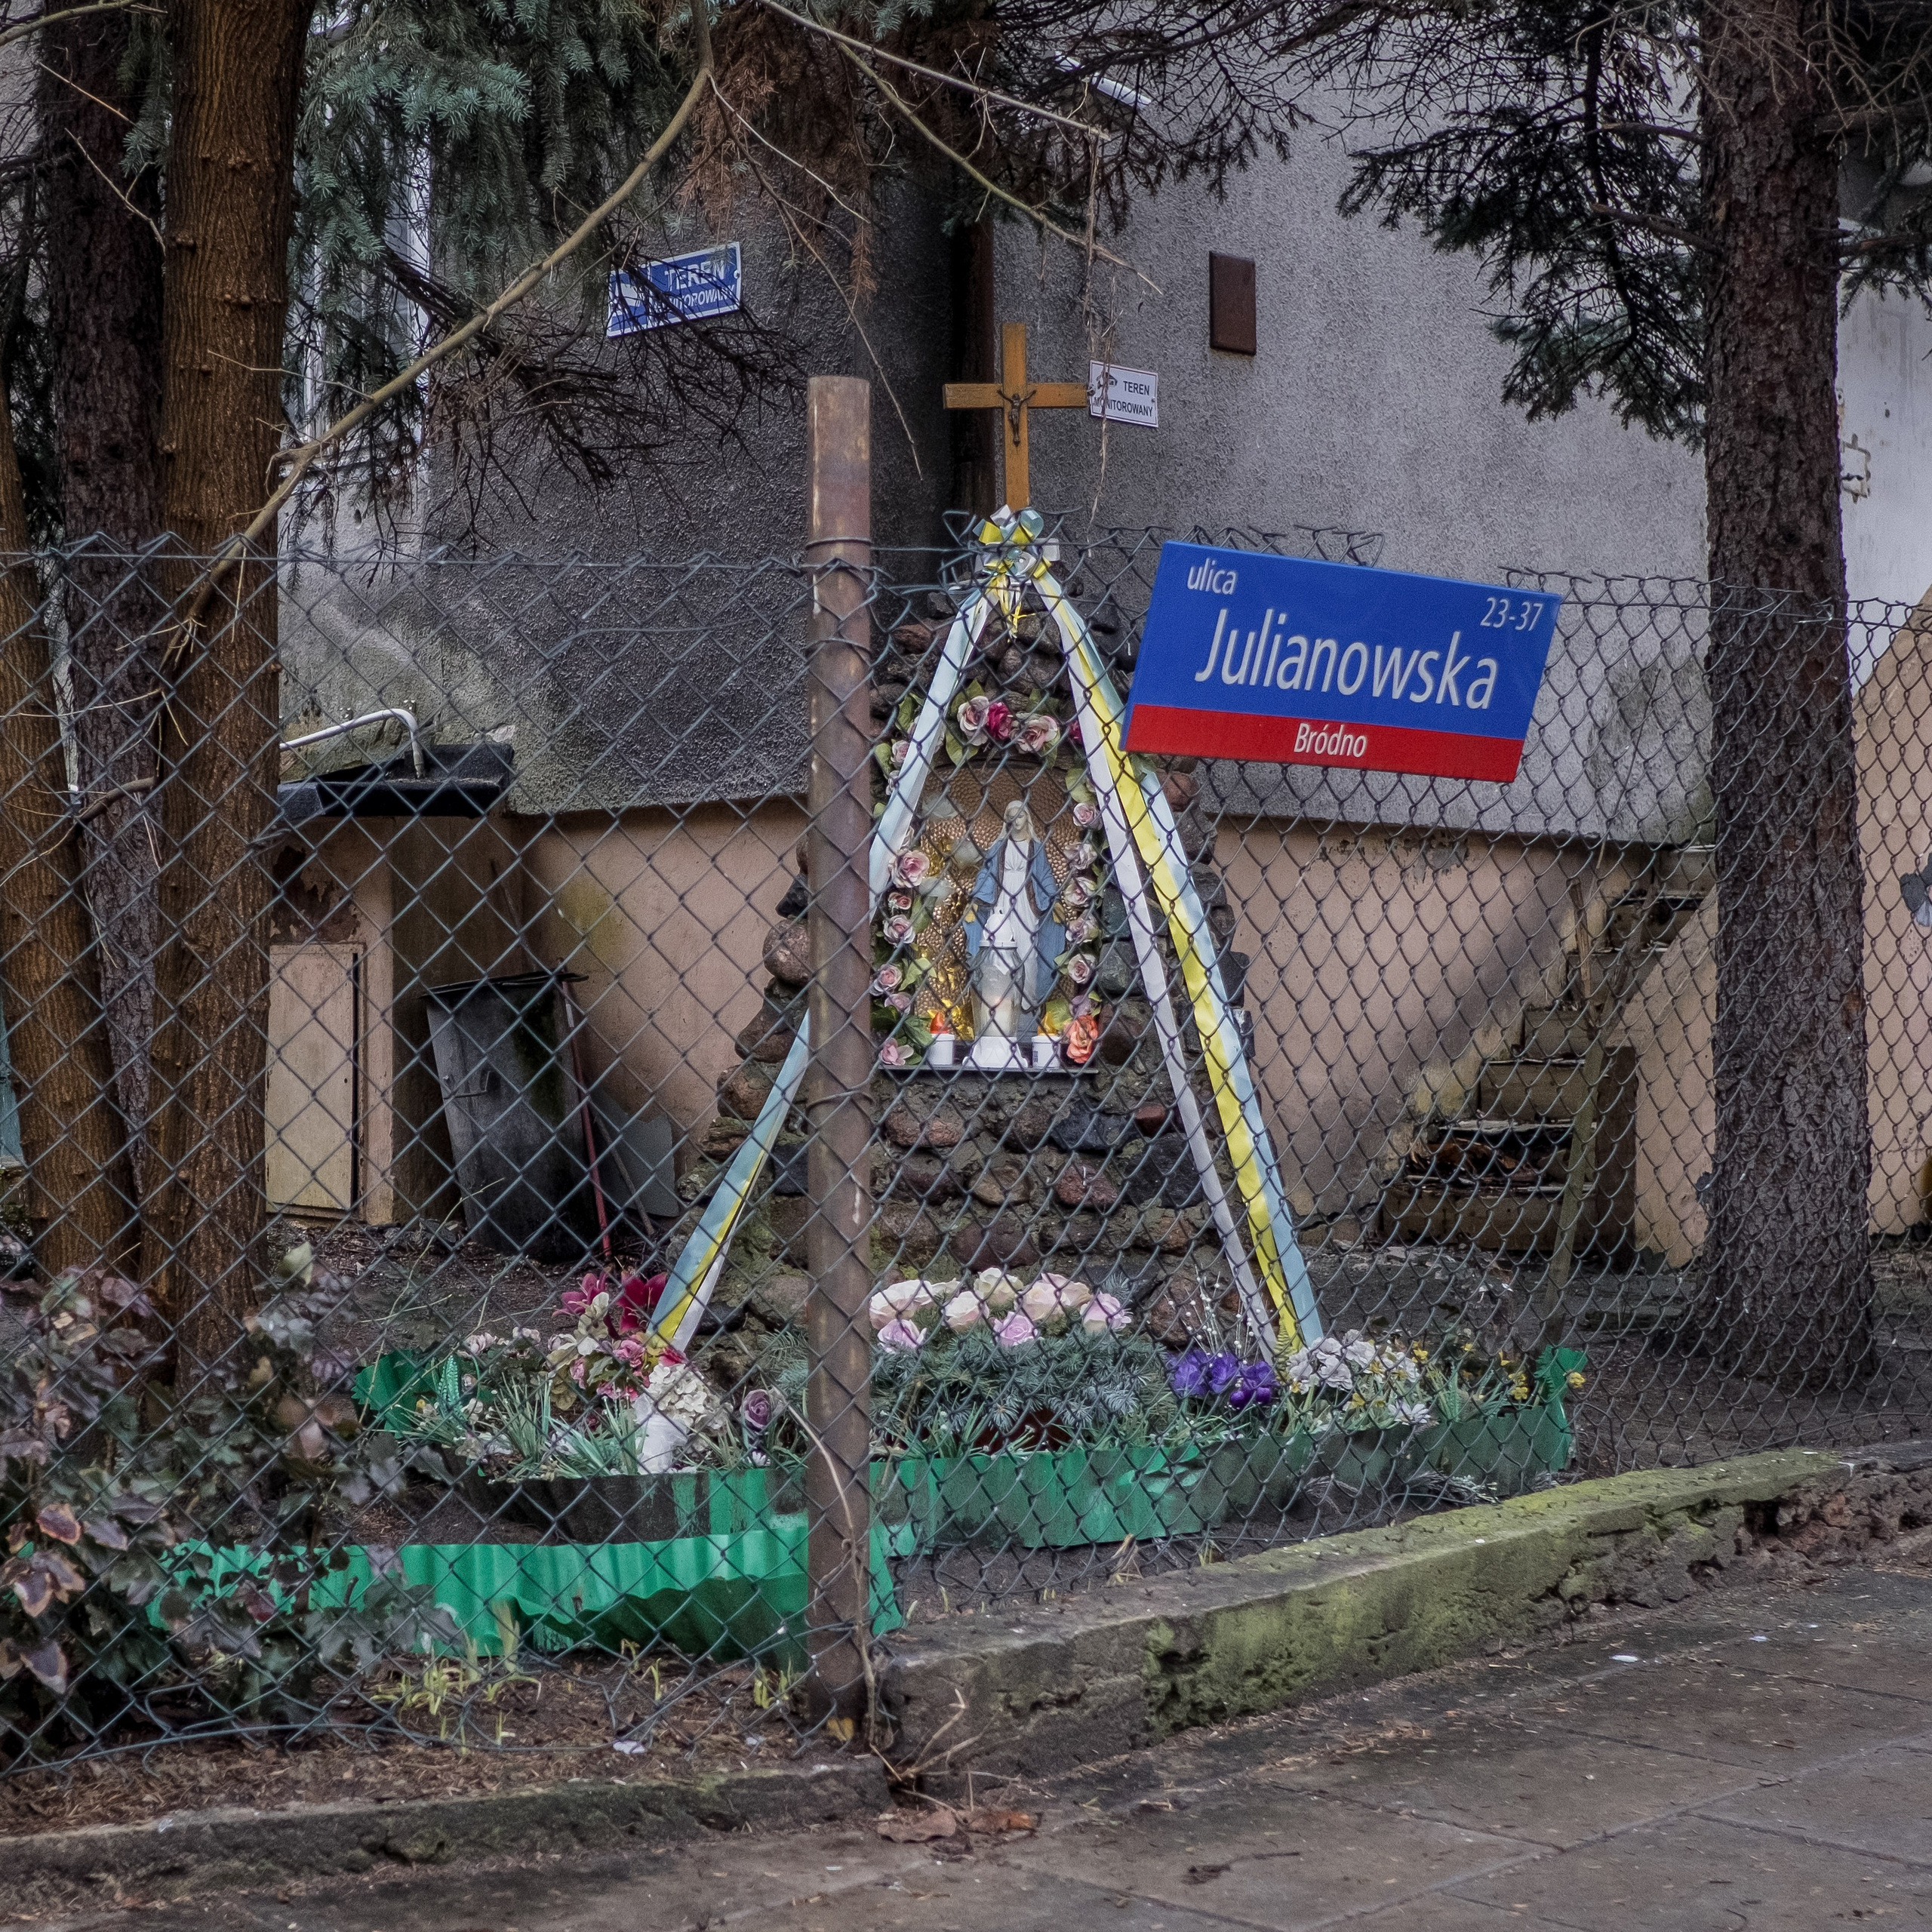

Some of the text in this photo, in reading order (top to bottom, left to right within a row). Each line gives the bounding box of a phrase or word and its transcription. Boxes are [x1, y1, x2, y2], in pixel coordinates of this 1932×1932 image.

[665, 260, 724, 292] TEREN
[653, 285, 735, 314] NITOROWANY
[1123, 381, 1149, 395] TEREN
[1187, 558, 1236, 595] ulica
[1480, 597, 1543, 631] 23-37
[1195, 608, 1497, 709] Julianowska
[1294, 722, 1367, 758] Bródno
